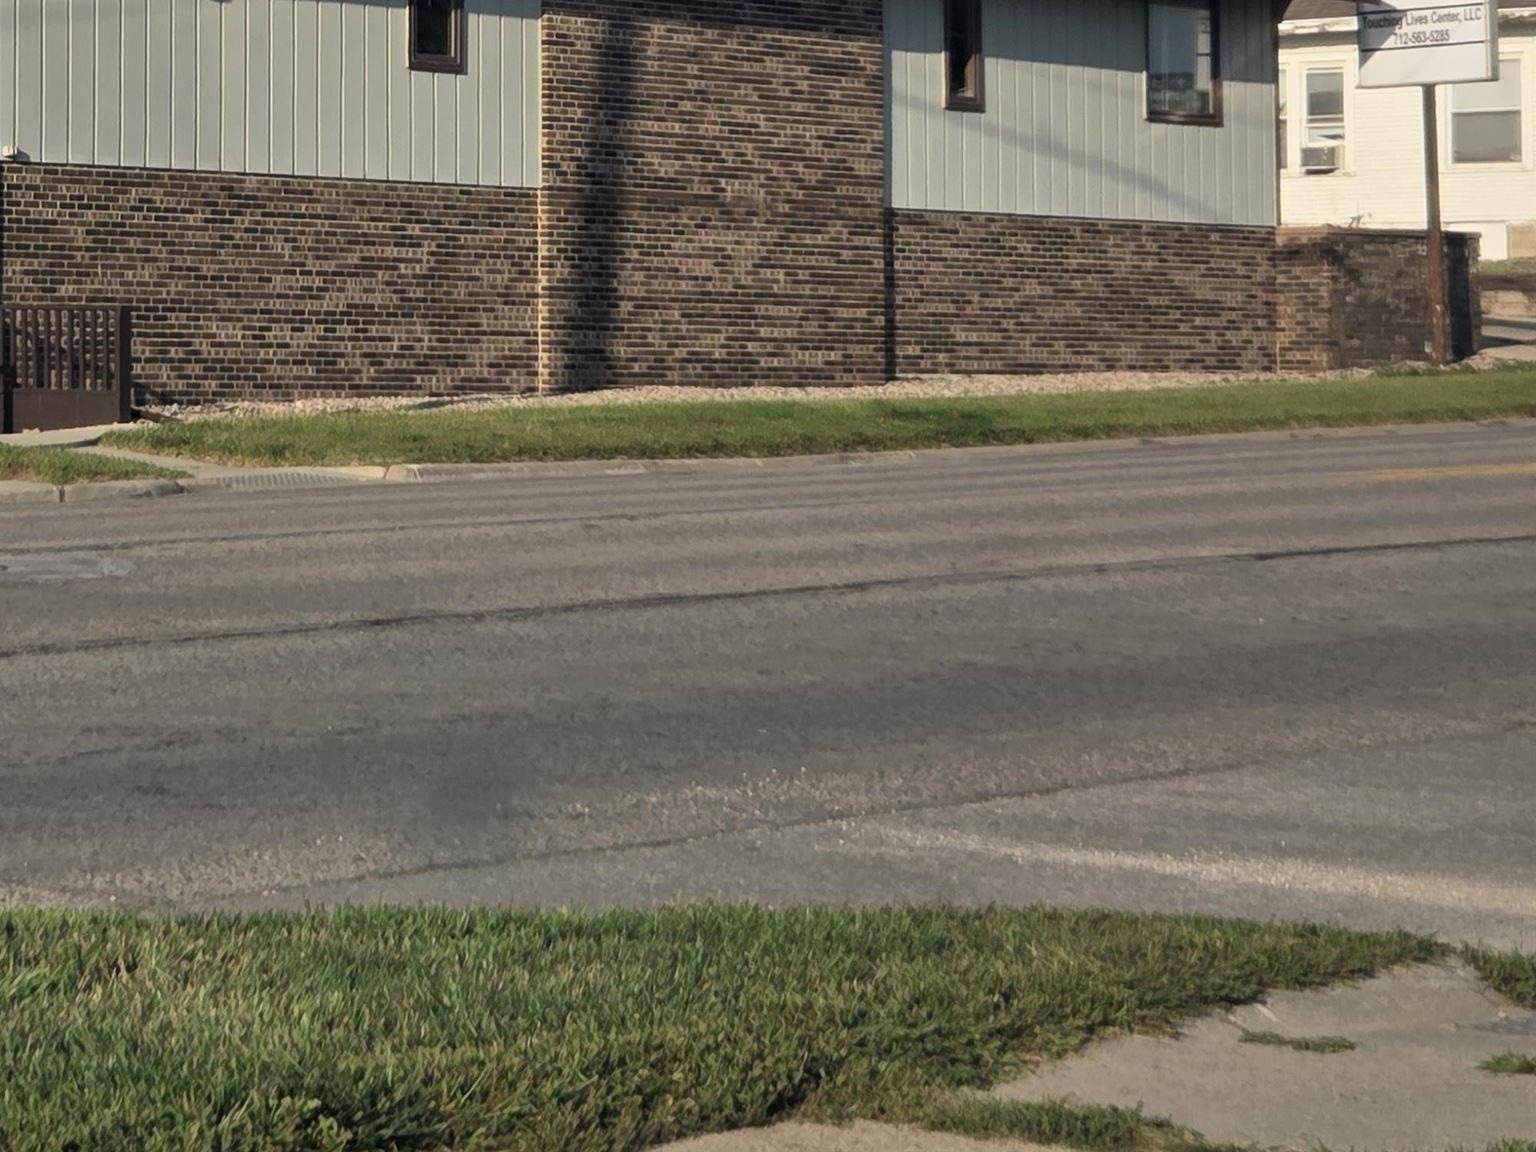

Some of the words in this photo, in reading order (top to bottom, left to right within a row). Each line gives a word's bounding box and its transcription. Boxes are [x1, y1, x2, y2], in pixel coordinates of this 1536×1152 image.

[1363, 15, 1403, 30] Touching
[1406, 12, 1429, 25] Lives
[1431, 11, 1461, 24] Center,
[1464, 8, 1482, 21] LLC
